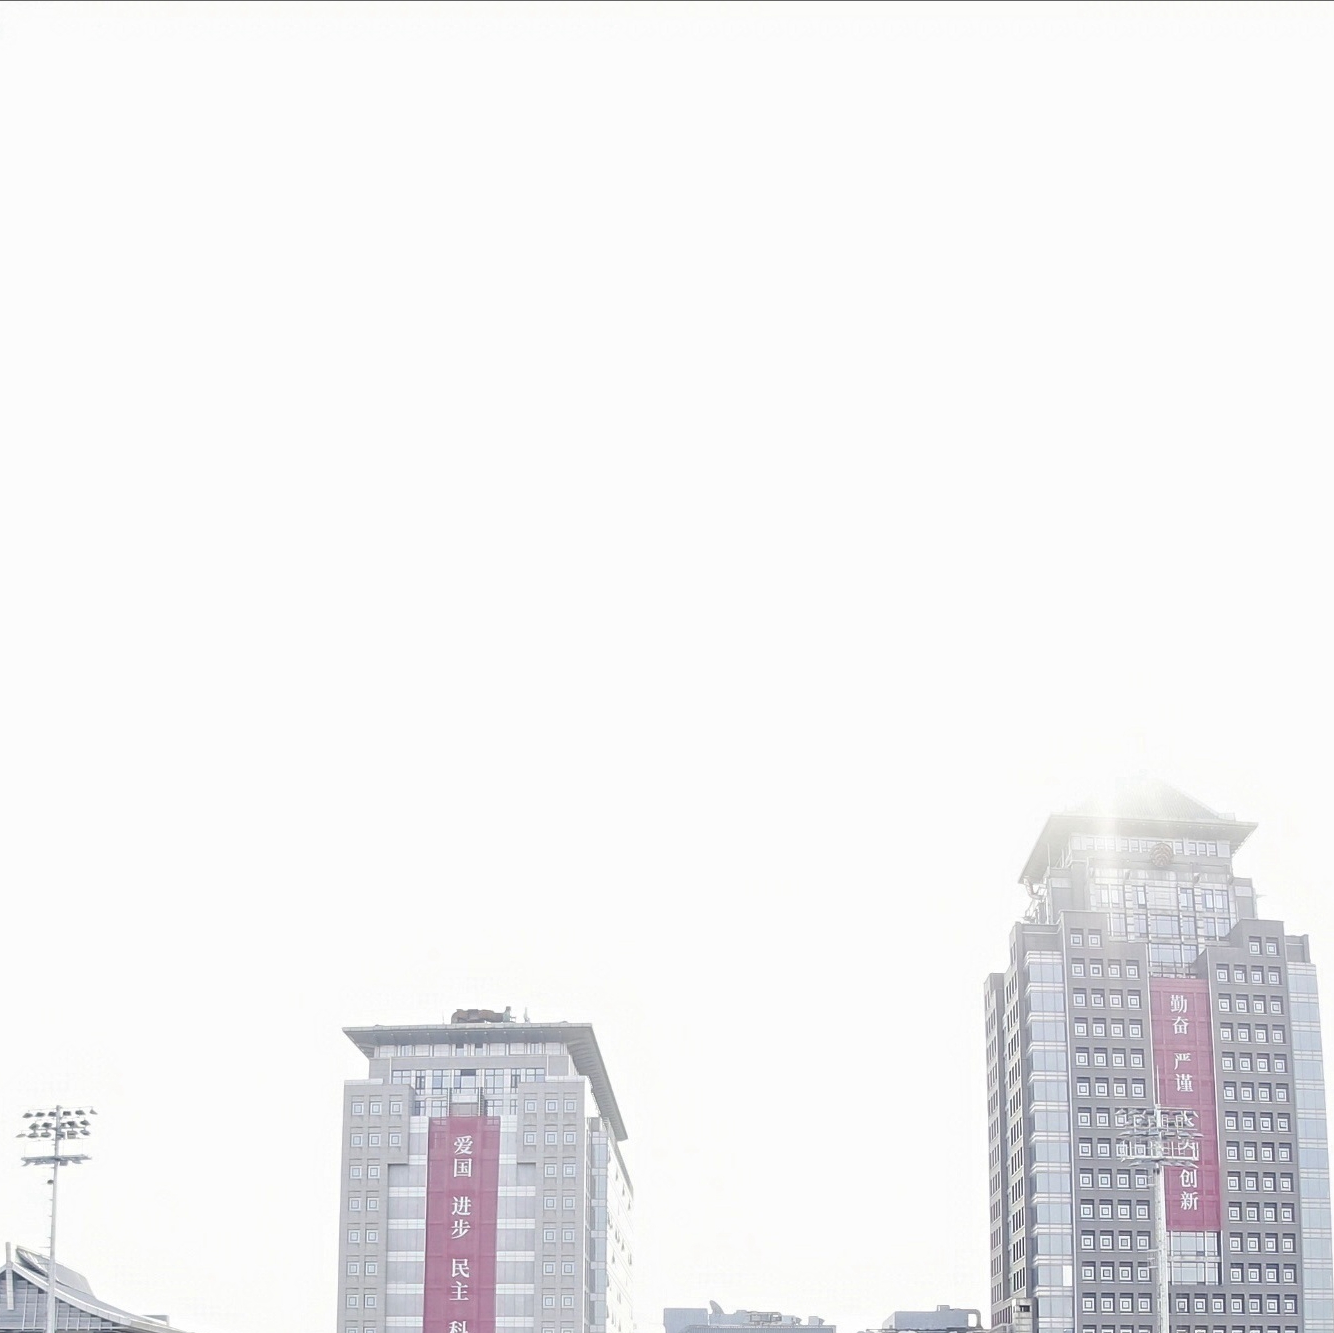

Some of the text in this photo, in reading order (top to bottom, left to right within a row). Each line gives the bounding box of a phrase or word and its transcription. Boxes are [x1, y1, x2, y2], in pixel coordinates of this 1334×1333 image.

[1170, 994, 1190, 1035] 勤奋
[1173, 1052, 1194, 1093] 严谨
[453, 1135, 473, 1178] 爱国
[1179, 1168, 1199, 1211] 创新
[451, 1196, 471, 1240] 进步
[449, 1258, 469, 1301] 民主
